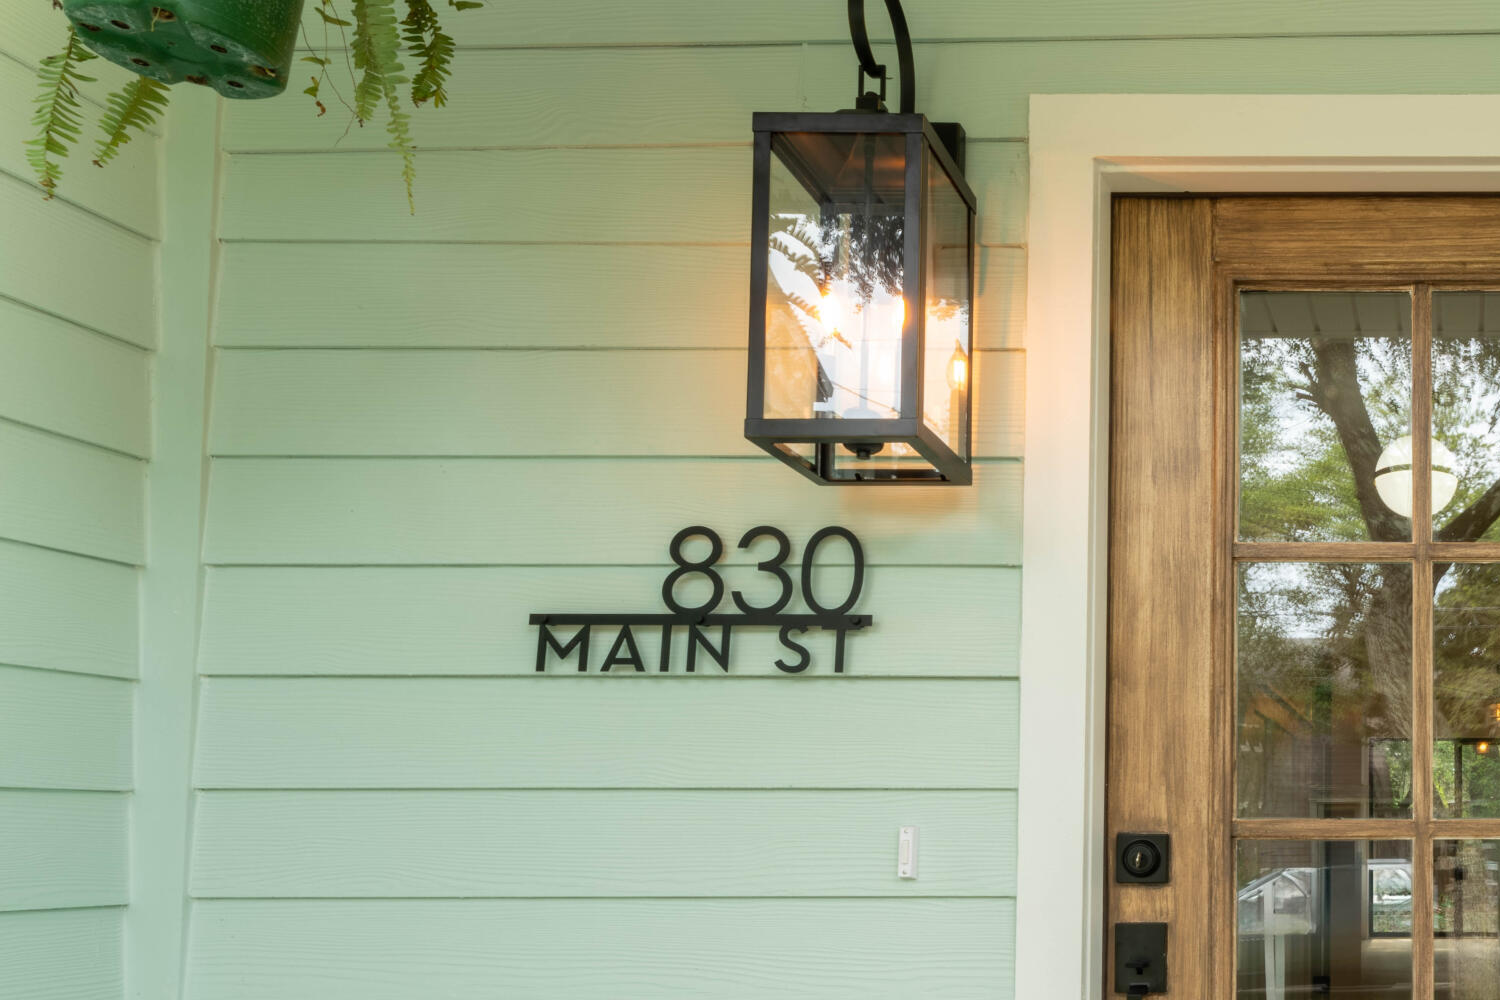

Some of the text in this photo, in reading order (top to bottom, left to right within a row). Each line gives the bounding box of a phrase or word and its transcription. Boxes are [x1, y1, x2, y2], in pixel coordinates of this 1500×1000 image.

[662, 525, 865, 616] 830
[535, 620, 864, 674] MAIN ST
